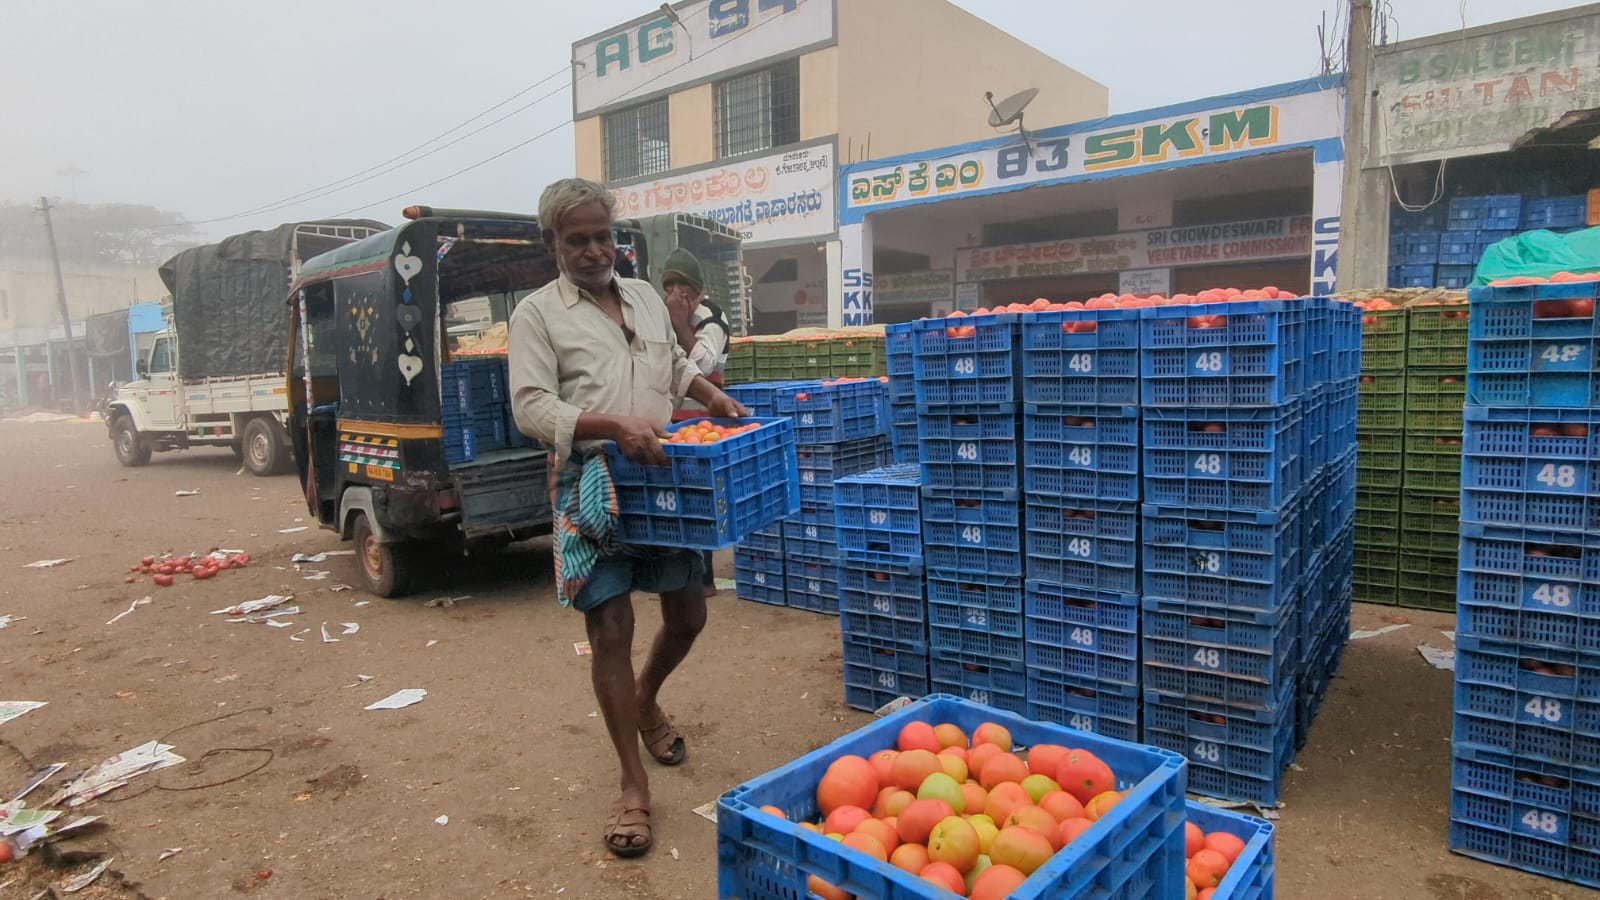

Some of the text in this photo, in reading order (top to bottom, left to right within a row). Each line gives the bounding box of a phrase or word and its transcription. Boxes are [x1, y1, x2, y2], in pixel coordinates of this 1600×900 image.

[595, 0, 798, 78] AG 9
[996, 138, 1071, 180] 83
[1083, 104, 1280, 172] SKM
[1146, 229, 1168, 246] SRI
[1169, 218, 1283, 245] CHOWDESWARI
[1146, 241, 1220, 265] VEGETABLE
[844, 268, 862, 327] SKM
[954, 357, 974, 375] 48
[1069, 353, 1092, 373] 48
[1195, 351, 1222, 372] 48
[801, 413, 814, 425] 48
[957, 442, 977, 461] 48
[1069, 446, 1092, 466] 48
[1194, 453, 1221, 475] 48
[802, 471, 814, 482] 48
[1536, 463, 1576, 489] 48
[656, 490, 677, 511] 48
[870, 509, 887, 525] 48
[806, 525, 817, 539] 48
[962, 525, 982, 544] 48
[1068, 537, 1091, 557] 48
[754, 571, 765, 584] 48
[808, 579, 820, 593] 48
[873, 595, 890, 613] 48
[1532, 582, 1571, 607] 48
[967, 615, 987, 626] 42
[1070, 626, 1093, 646] 48
[1193, 647, 1220, 669] 48
[878, 671, 895, 688] 48
[969, 688, 989, 705] 48
[1524, 695, 1563, 723] 48
[1070, 713, 1093, 733] 48
[1193, 741, 1220, 763] 48
[1521, 808, 1559, 835] 48
